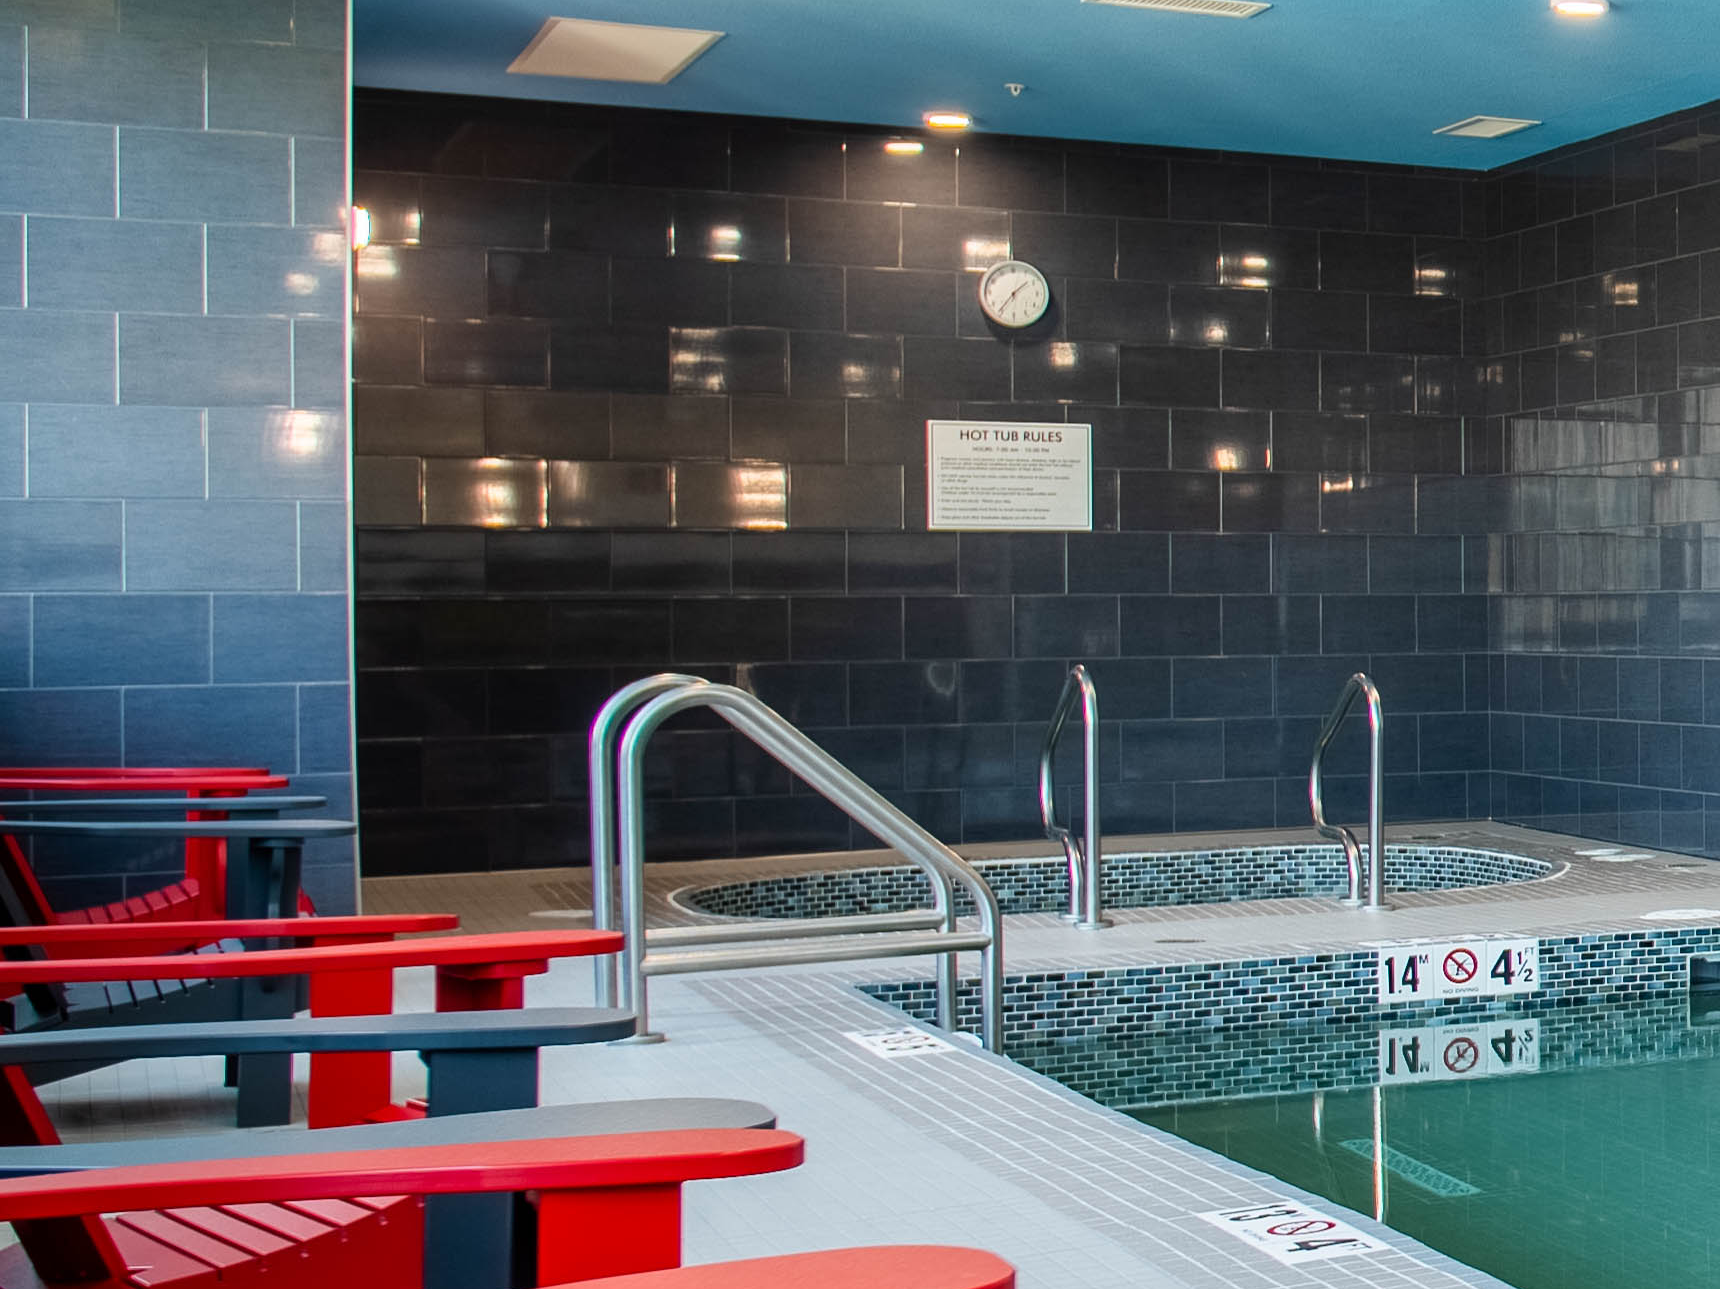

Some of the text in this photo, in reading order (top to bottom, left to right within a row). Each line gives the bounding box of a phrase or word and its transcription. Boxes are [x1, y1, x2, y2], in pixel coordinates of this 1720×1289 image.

[960, 429, 1063, 443] HOT TUB RULES
[1419, 954, 1429, 964] M
